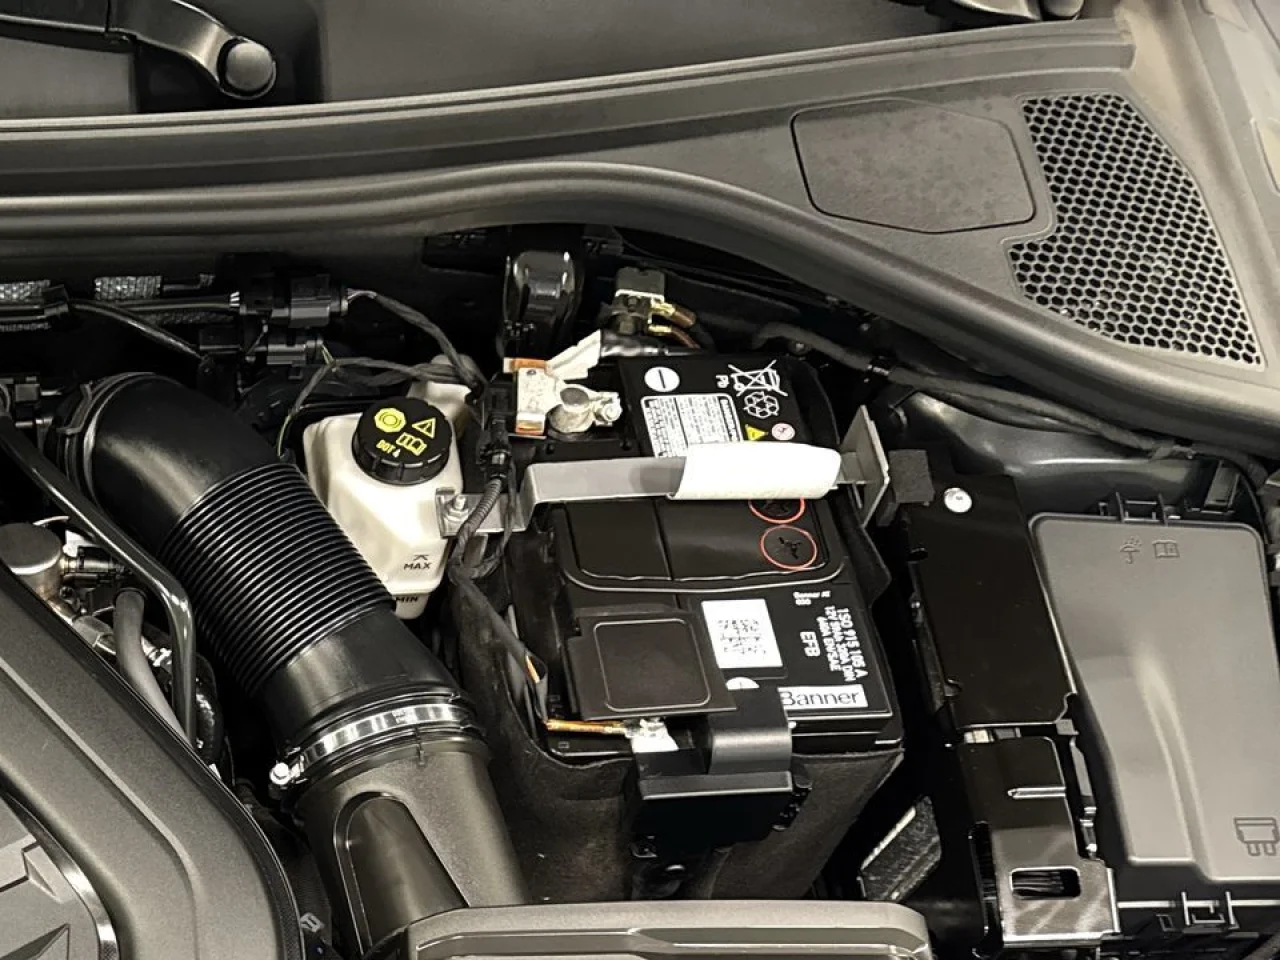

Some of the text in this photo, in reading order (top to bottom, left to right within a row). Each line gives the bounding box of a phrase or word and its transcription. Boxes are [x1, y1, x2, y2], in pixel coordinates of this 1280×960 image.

[375, 439, 396, 454] DOT
[403, 562, 432, 570] MAX
[799, 631, 821, 657] EFB
[854, 668, 869, 679] A
[780, 690, 860, 706] Banner
